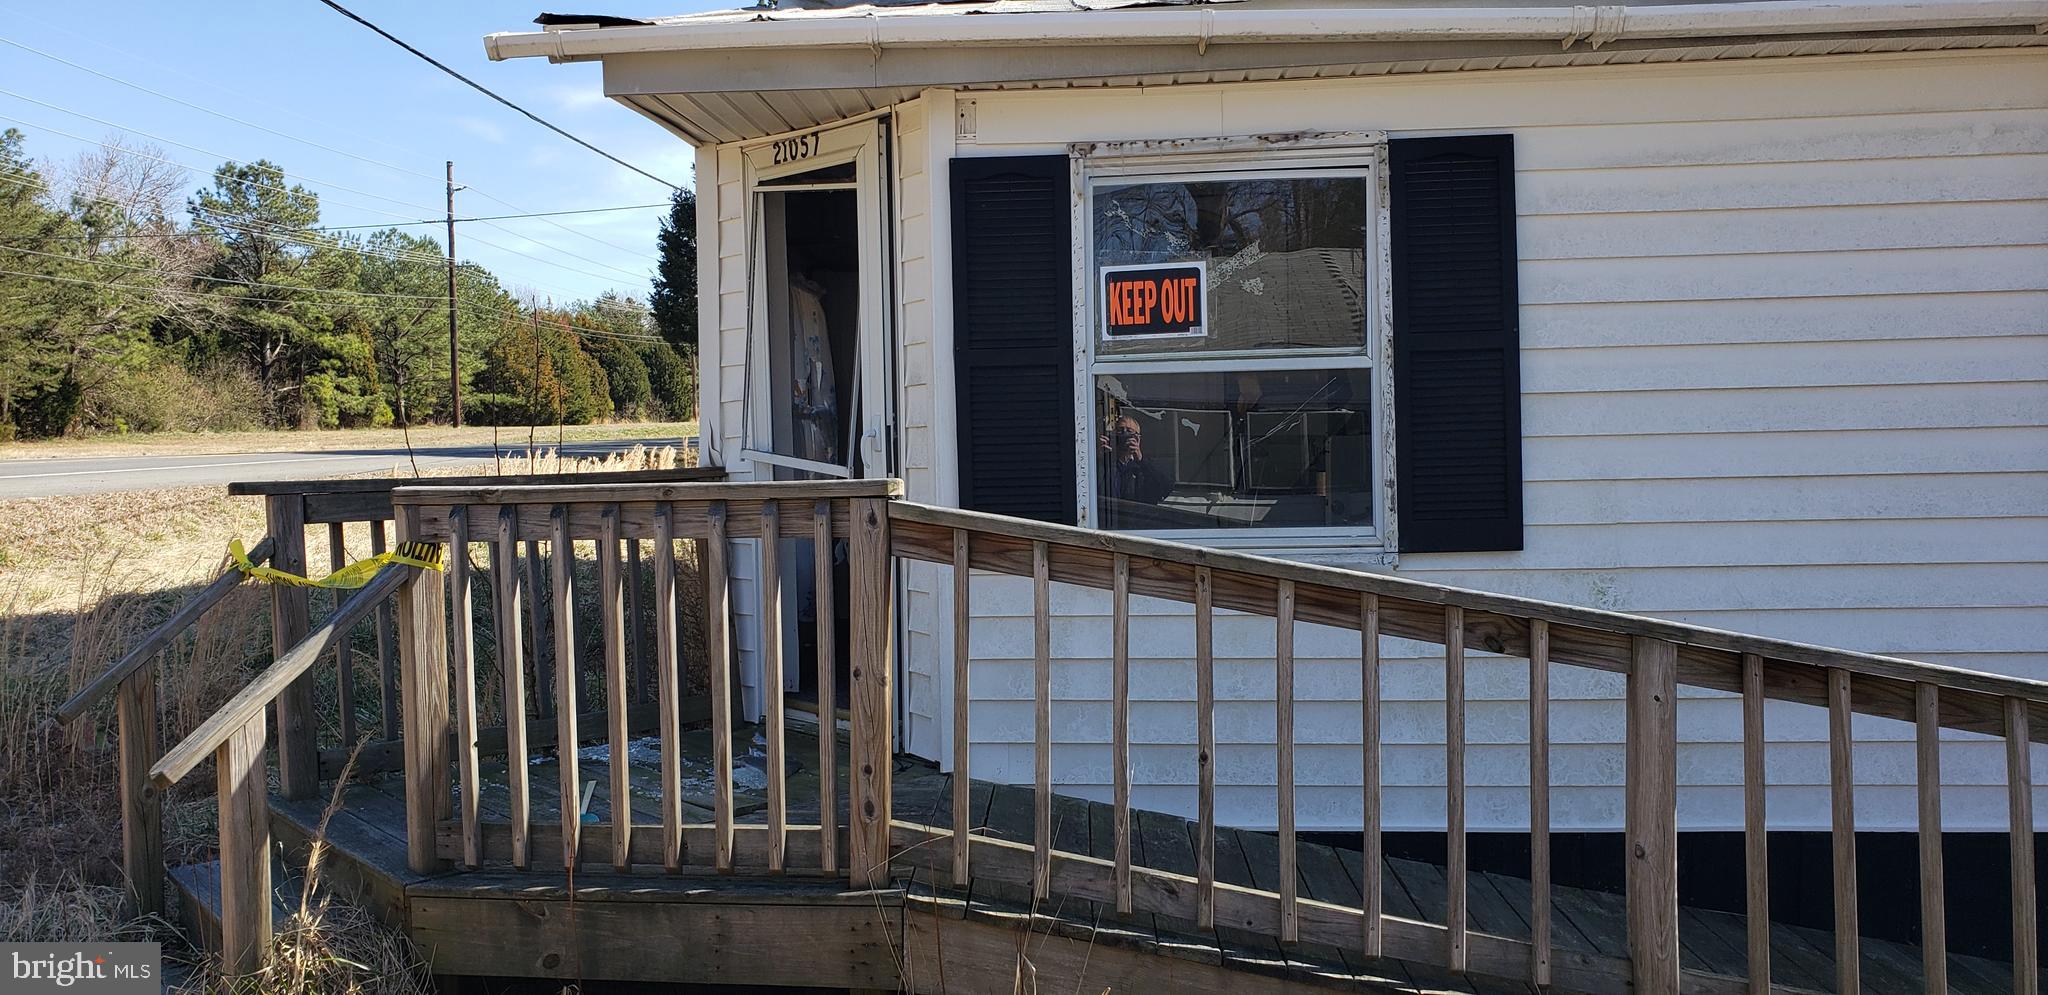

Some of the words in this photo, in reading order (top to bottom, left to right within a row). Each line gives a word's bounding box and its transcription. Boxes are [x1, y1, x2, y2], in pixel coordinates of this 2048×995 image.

[772, 131, 820, 165] 21057
[1109, 280, 1157, 326] KEEP
[1161, 277, 1197, 324] OUT
